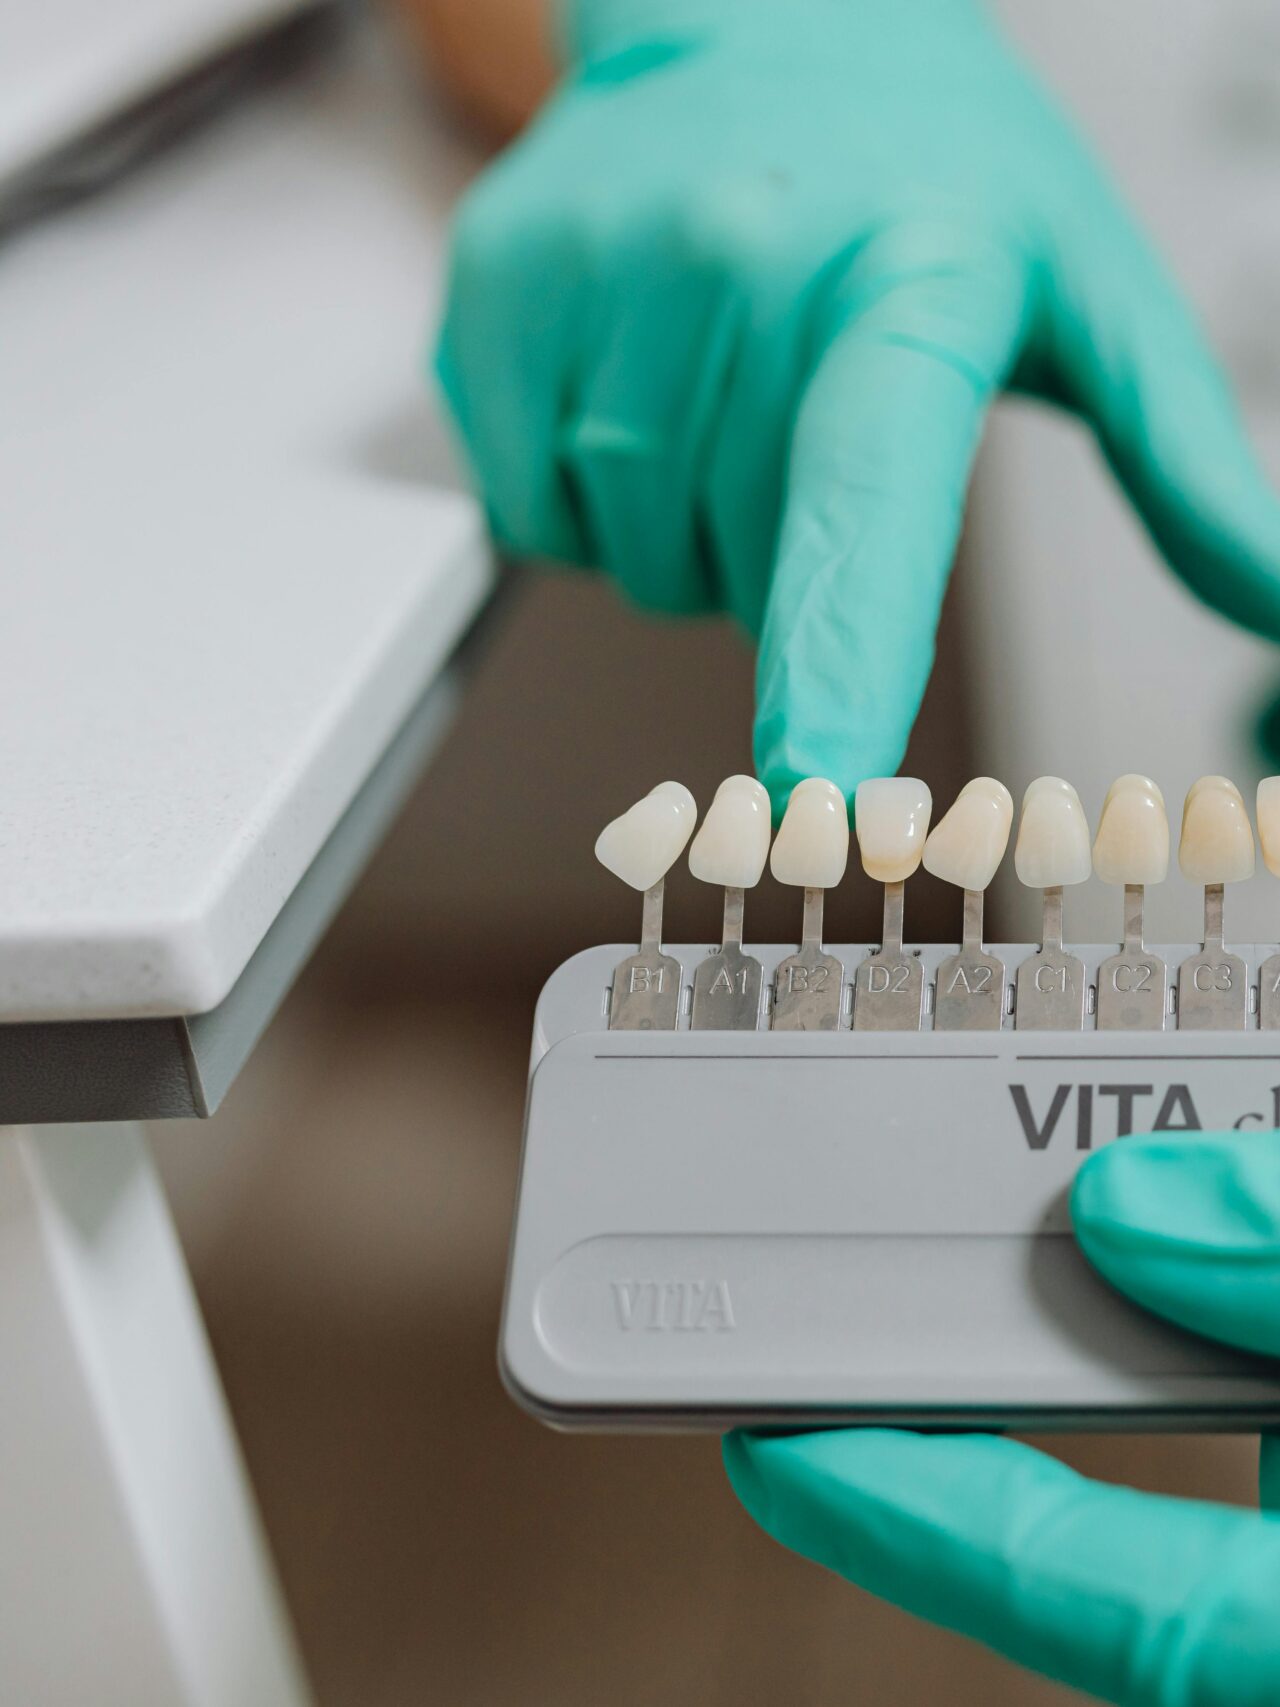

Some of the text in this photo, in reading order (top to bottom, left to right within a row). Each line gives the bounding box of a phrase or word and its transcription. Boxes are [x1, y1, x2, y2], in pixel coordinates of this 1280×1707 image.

[629, 966, 666, 993] B1
[709, 966, 748, 994] A1
[787, 965, 830, 993] B2
[868, 965, 911, 993] D2
[947, 964, 993, 994] A2
[1034, 964, 1068, 993] C1
[1112, 964, 1152, 992] C2
[1193, 963, 1232, 992] C3
[1008, 1084, 1203, 1150] VITA
[610, 1279, 738, 1332] VITA
